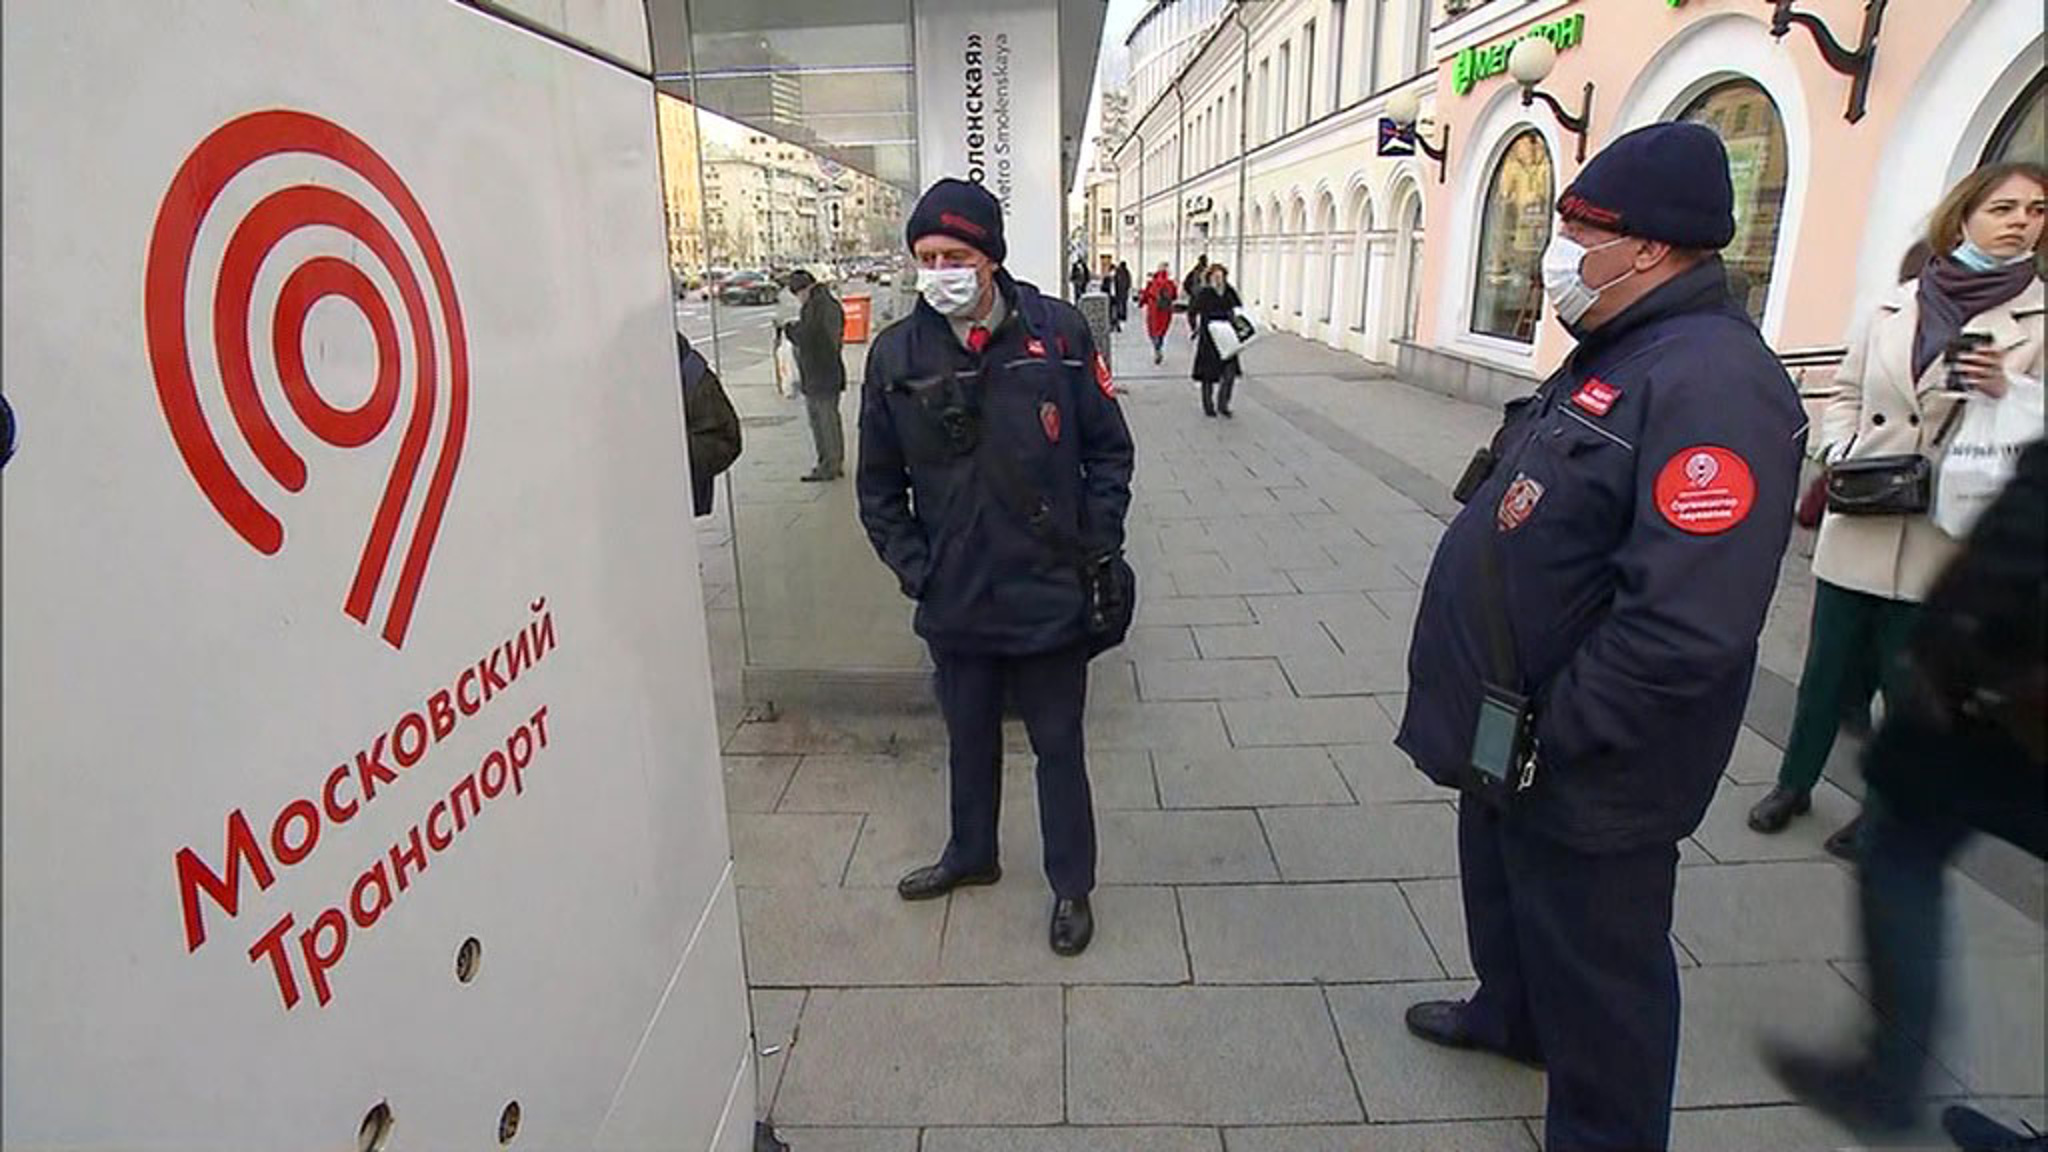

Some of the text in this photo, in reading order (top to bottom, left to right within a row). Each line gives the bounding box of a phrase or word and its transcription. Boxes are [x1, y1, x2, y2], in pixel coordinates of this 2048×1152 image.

[965, 32, 985, 185] оленская»
[993, 33, 1012, 154] Smolenskaya
[175, 596, 558, 954] Московский
[248, 705, 549, 1010] Транспорт
